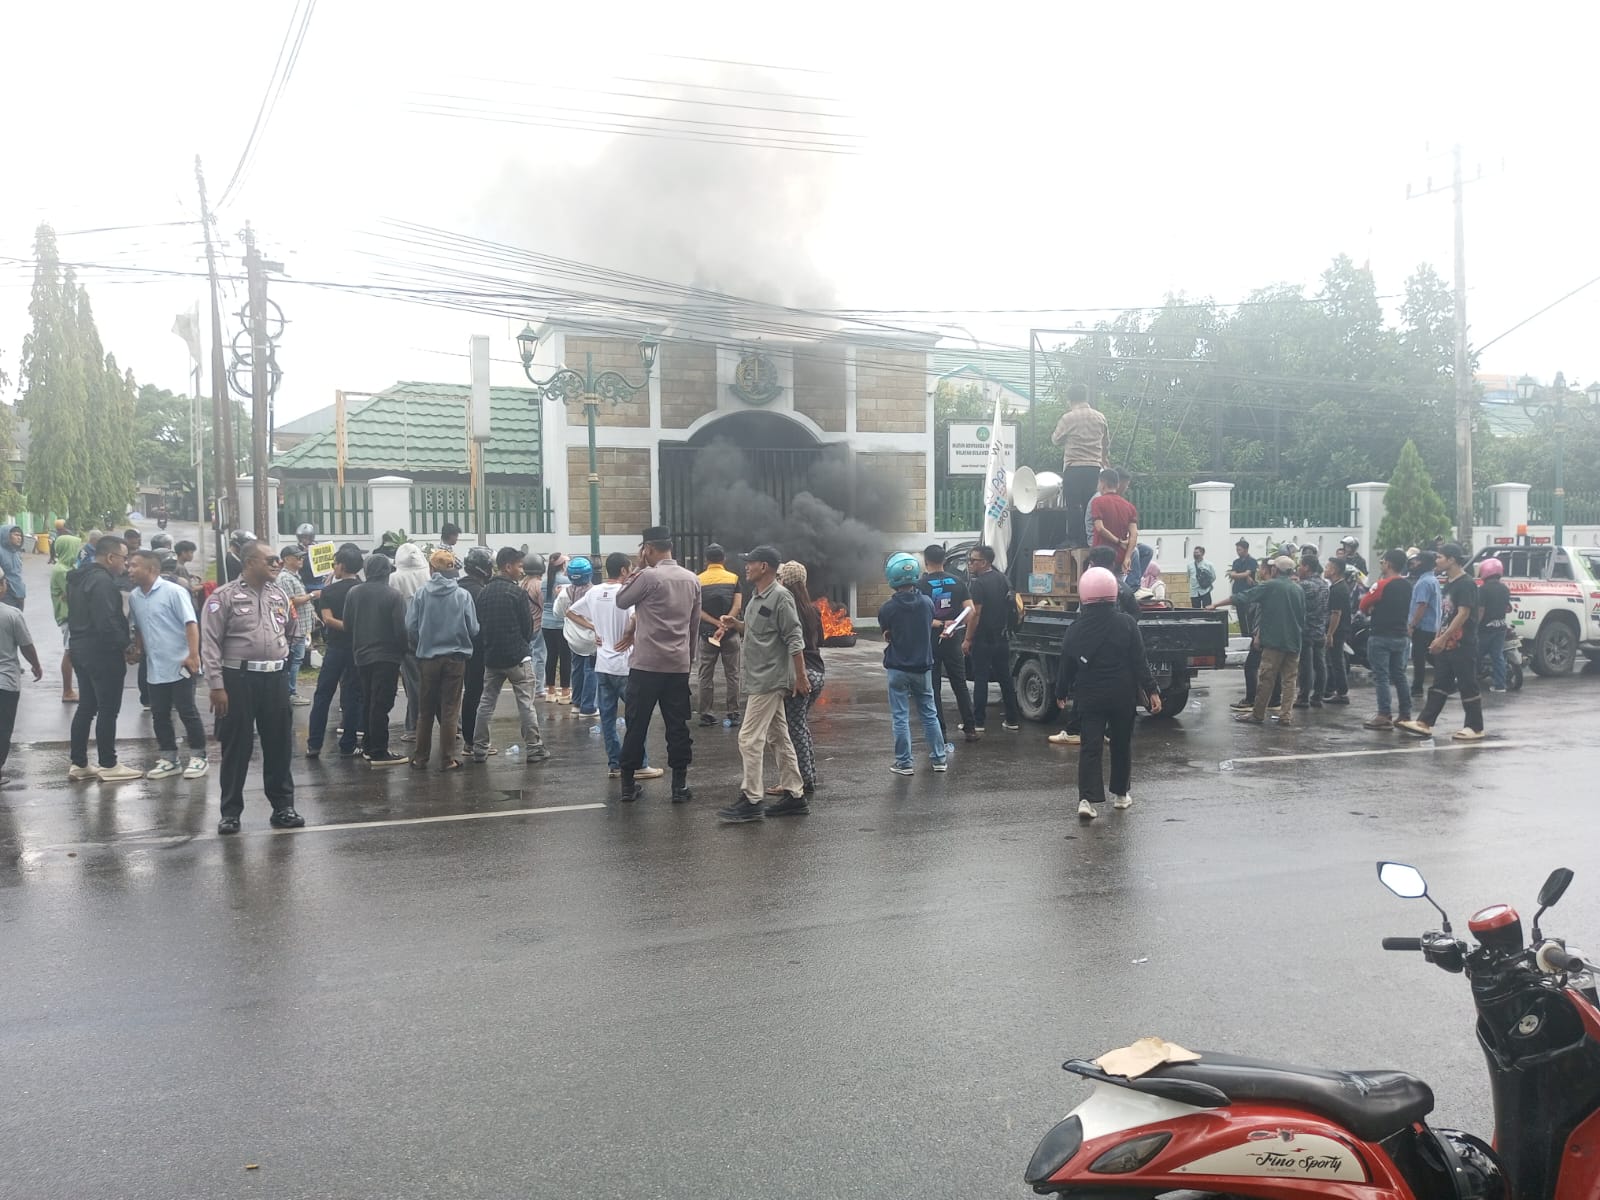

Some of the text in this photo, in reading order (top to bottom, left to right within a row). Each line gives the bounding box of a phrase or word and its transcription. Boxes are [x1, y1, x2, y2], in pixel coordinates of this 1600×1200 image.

[1518, 610, 1537, 620] 001
[1256, 1151, 1343, 1173] Fino Sporty
